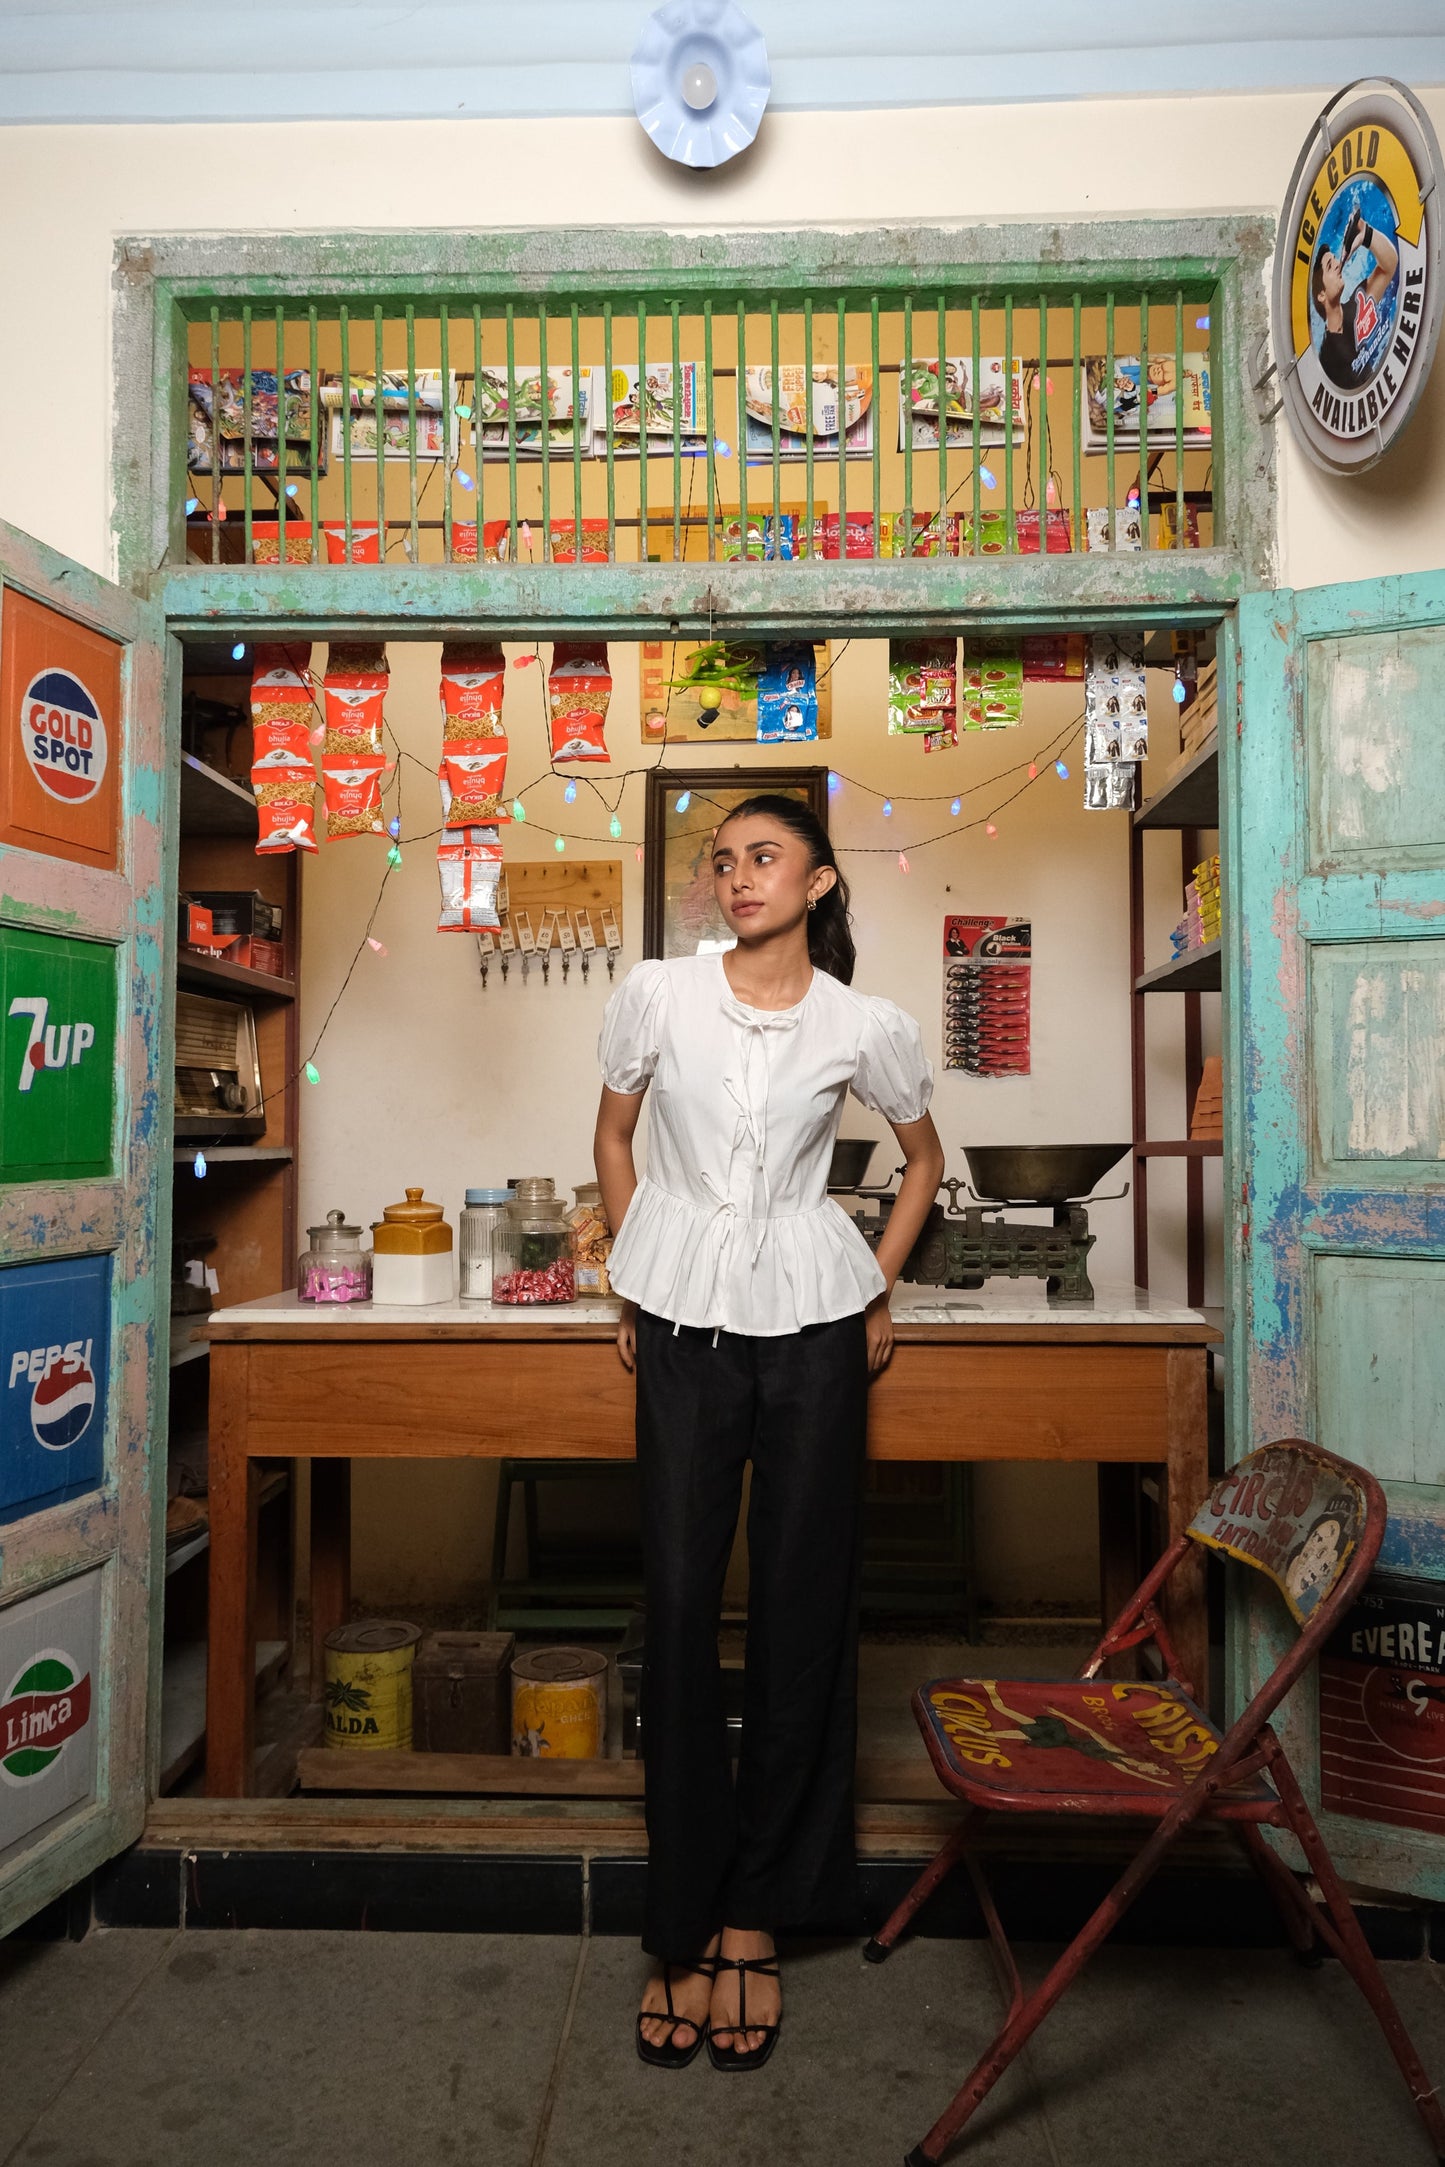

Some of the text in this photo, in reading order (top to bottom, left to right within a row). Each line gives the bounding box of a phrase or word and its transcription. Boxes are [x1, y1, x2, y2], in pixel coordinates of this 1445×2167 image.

[1297, 130, 1380, 266] ICE COLD
[1312, 267, 1423, 433] AVAILABLE HERE
[825, 416, 836, 432] FREE
[459, 693, 483, 703] bhujia
[341, 710, 365, 720] bhujia
[461, 711, 482, 719] BIKAJI
[29, 703, 93, 750] GOLD
[565, 723, 588, 736] bhujia
[268, 735, 291, 745] bhujia
[33, 734, 93, 775] SPOT
[462, 777, 486, 786] bhujia
[339, 791, 363, 801] bhujia
[464, 794, 485, 802] BIKAJI
[271, 815, 296, 824] bhujia
[951, 917, 995, 929] Challenge
[992, 933, 1017, 942] Black
[8, 997, 96, 1093] 7UP
[8, 1338, 94, 1389] PEPSI
[1406, 1678, 1429, 1717] 9
[6, 1696, 73, 1751] Limca
[929, 1691, 1013, 1769] CIRCUS
